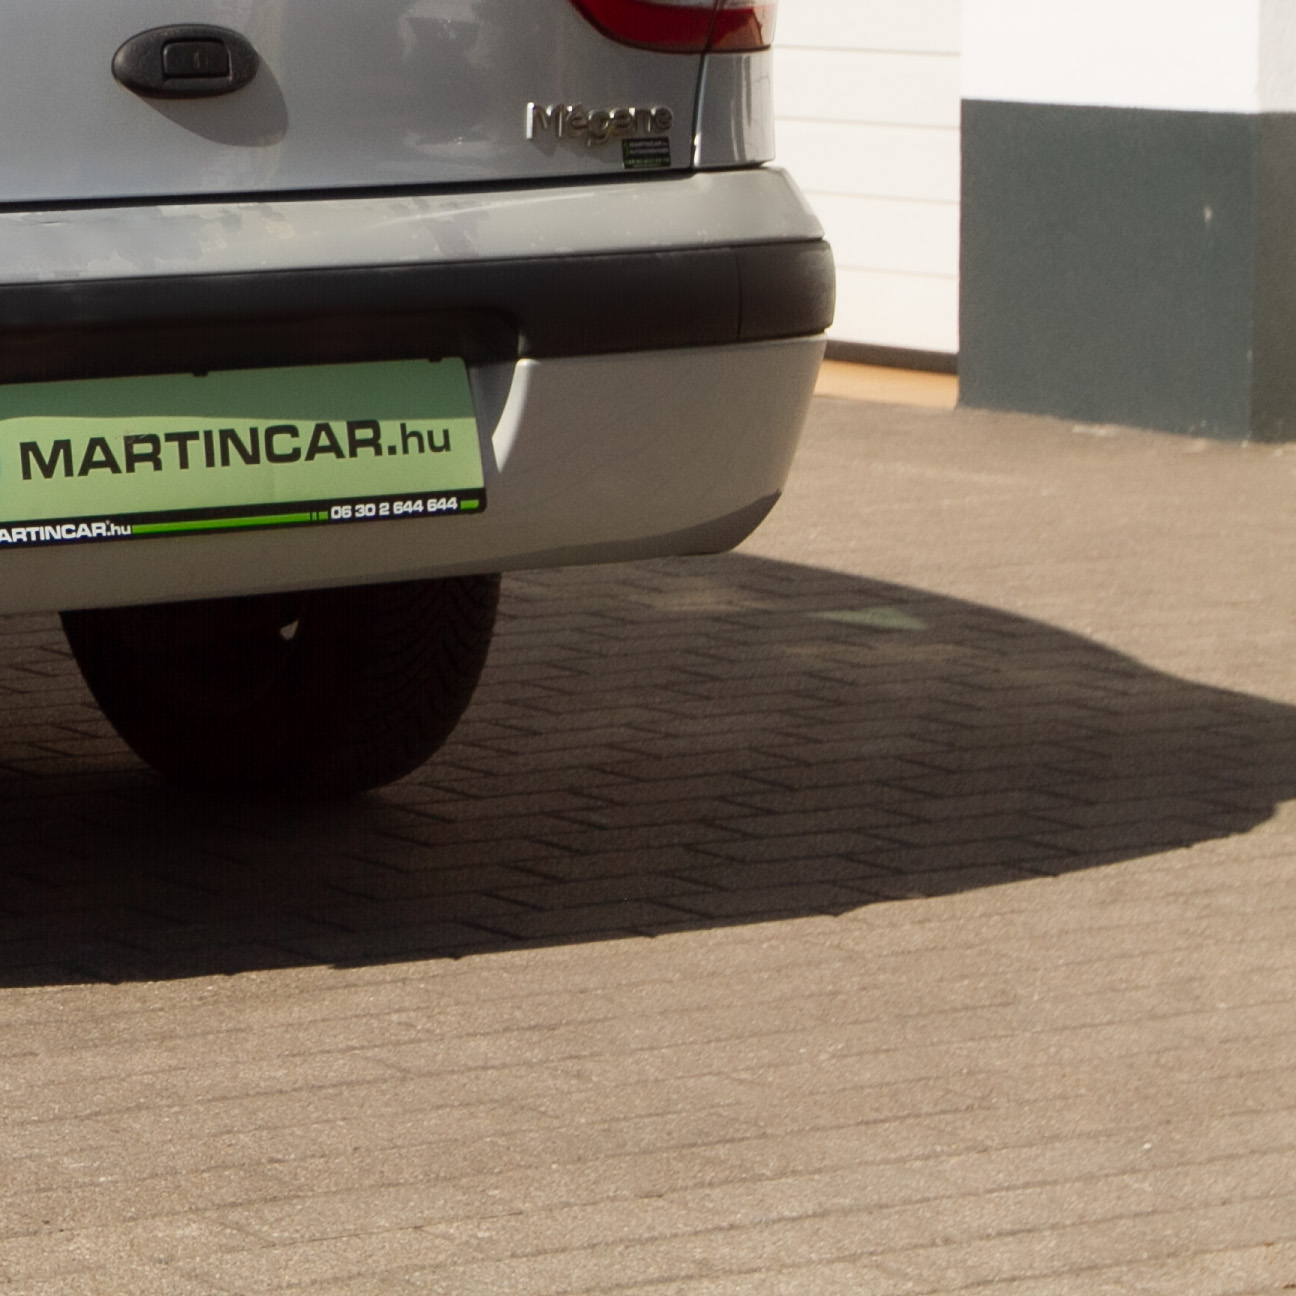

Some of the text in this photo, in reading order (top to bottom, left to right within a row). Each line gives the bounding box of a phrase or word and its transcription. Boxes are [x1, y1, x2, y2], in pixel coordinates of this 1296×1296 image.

[19, 418, 452, 481] MARTINCAR.hu
[330, 496, 458, 520] 06 30 2 644 644
